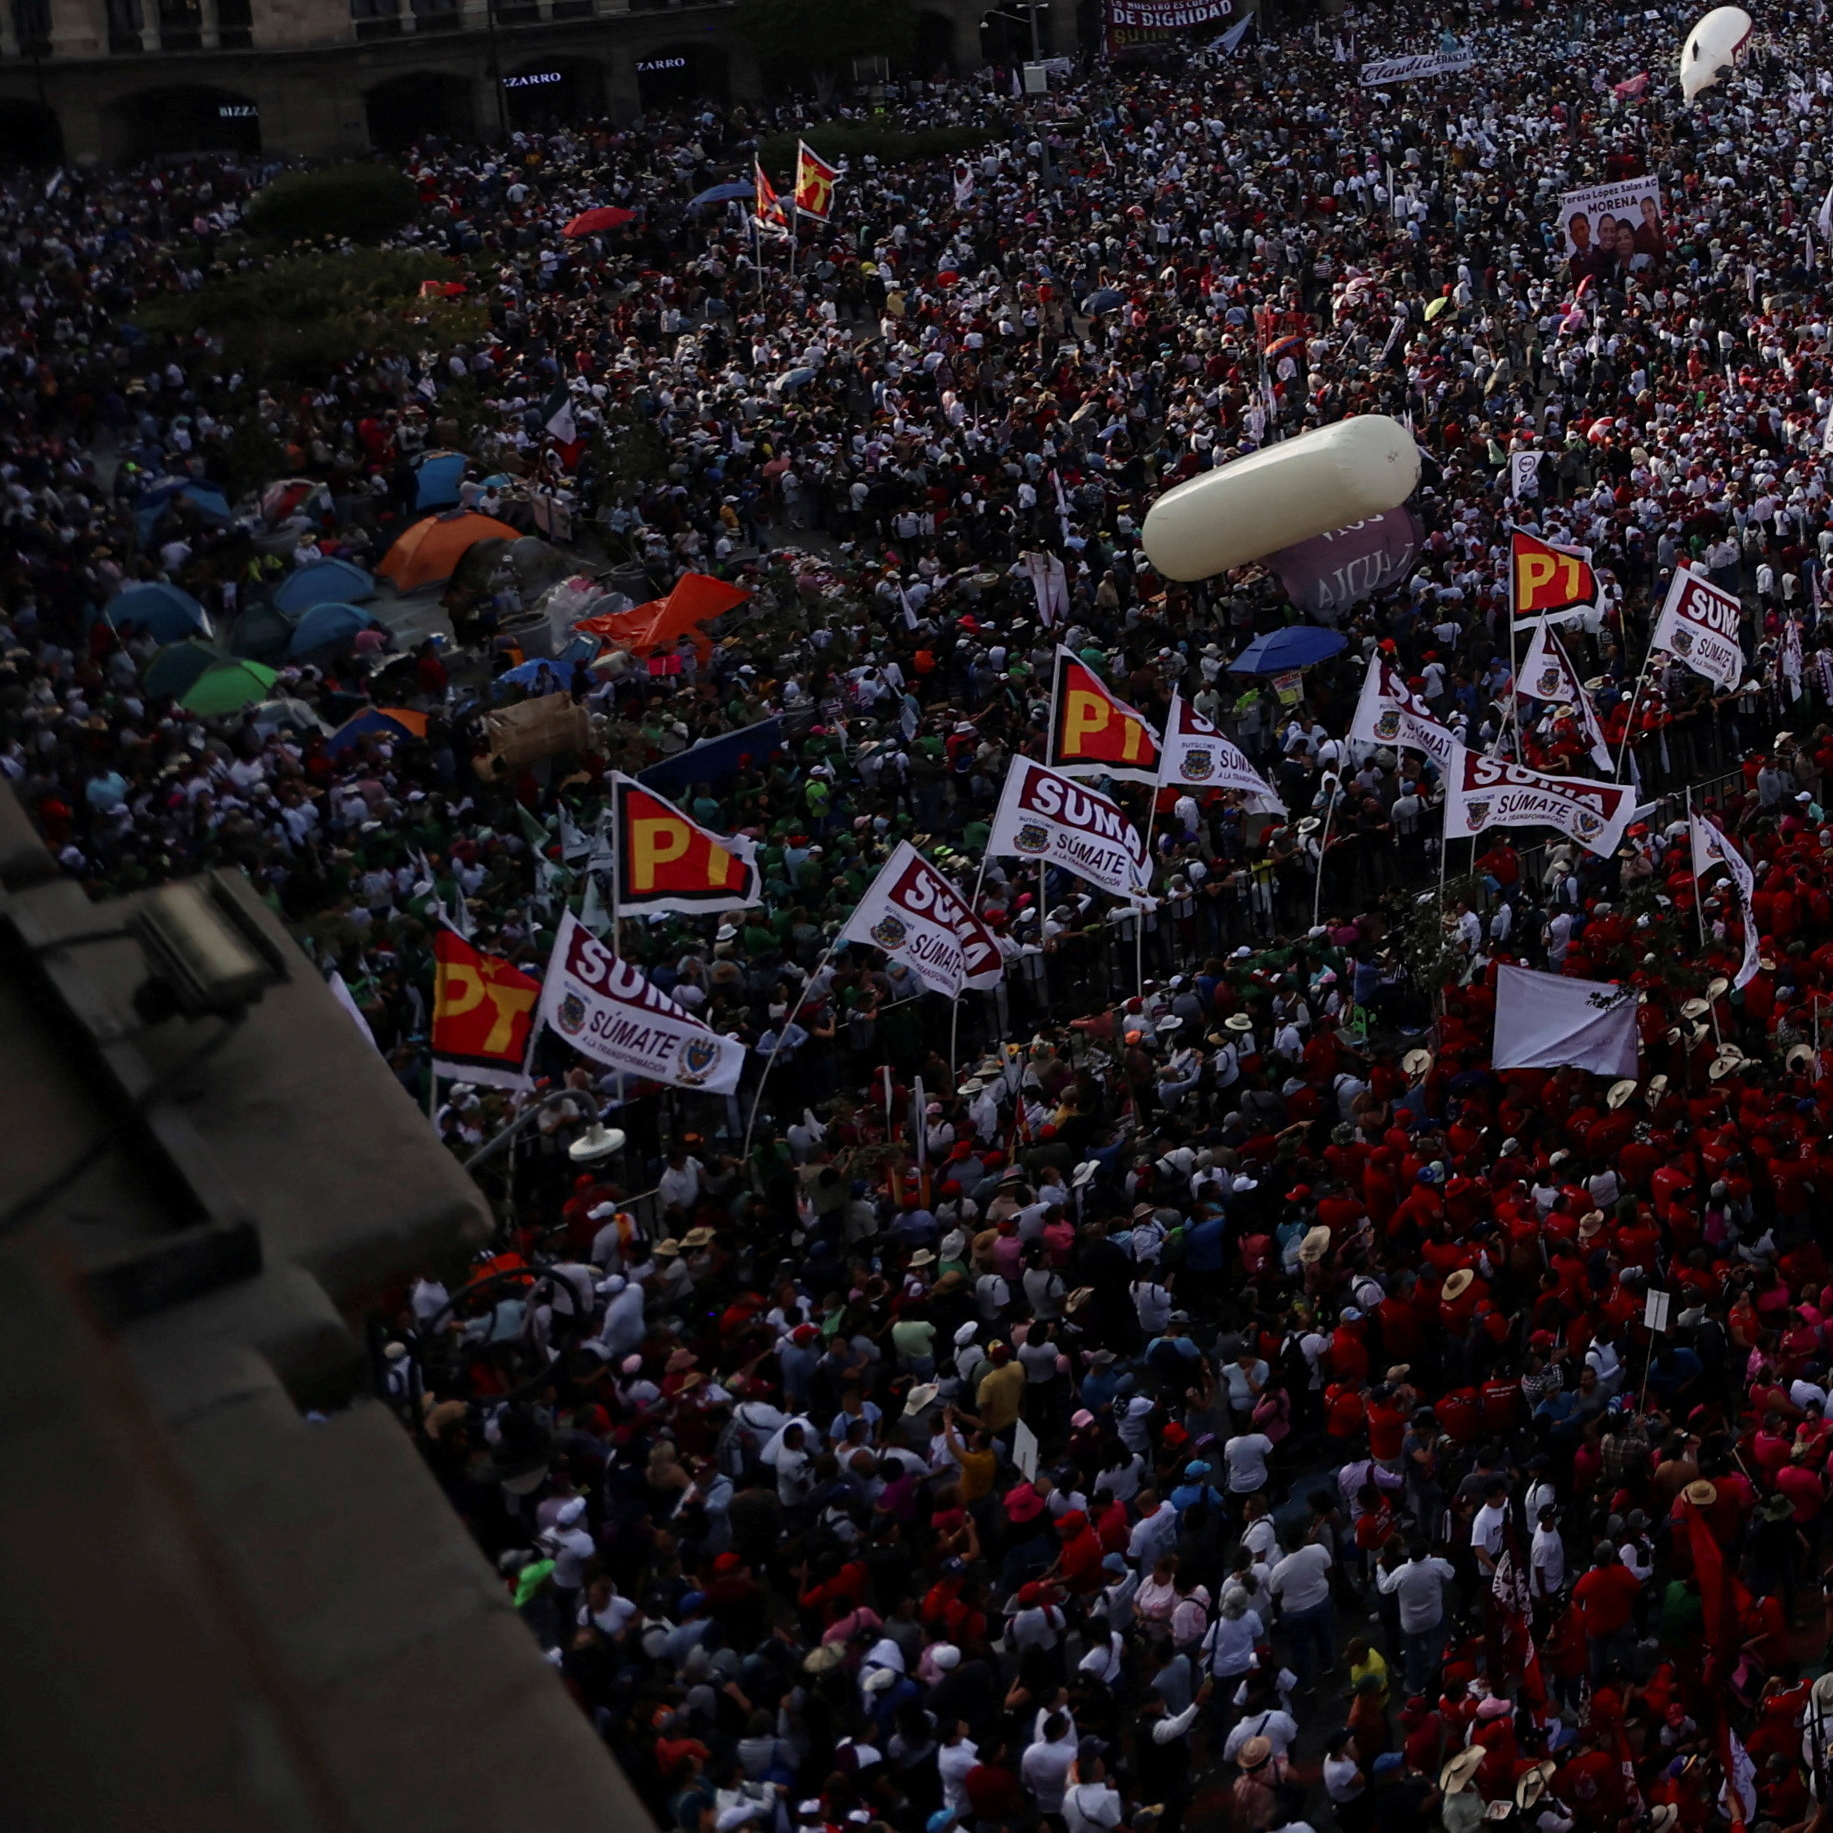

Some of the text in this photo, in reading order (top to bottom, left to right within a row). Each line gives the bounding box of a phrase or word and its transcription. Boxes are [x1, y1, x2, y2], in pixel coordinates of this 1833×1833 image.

[1113, 0, 1233, 27] DE DIGNIDAD
[1361, 57, 1433, 83] Claudia
[1587, 195, 1638, 215] MORENA
[1517, 553, 1582, 611] PT
[1030, 776, 1144, 860] SUMA
[1497, 790, 1572, 818] SÚMATE
[1056, 833, 1127, 875] SÚMATE
[909, 933, 961, 978] SÚMATE
[433, 962, 539, 1054] PT
[589, 1010, 680, 1060] SÚMATE
